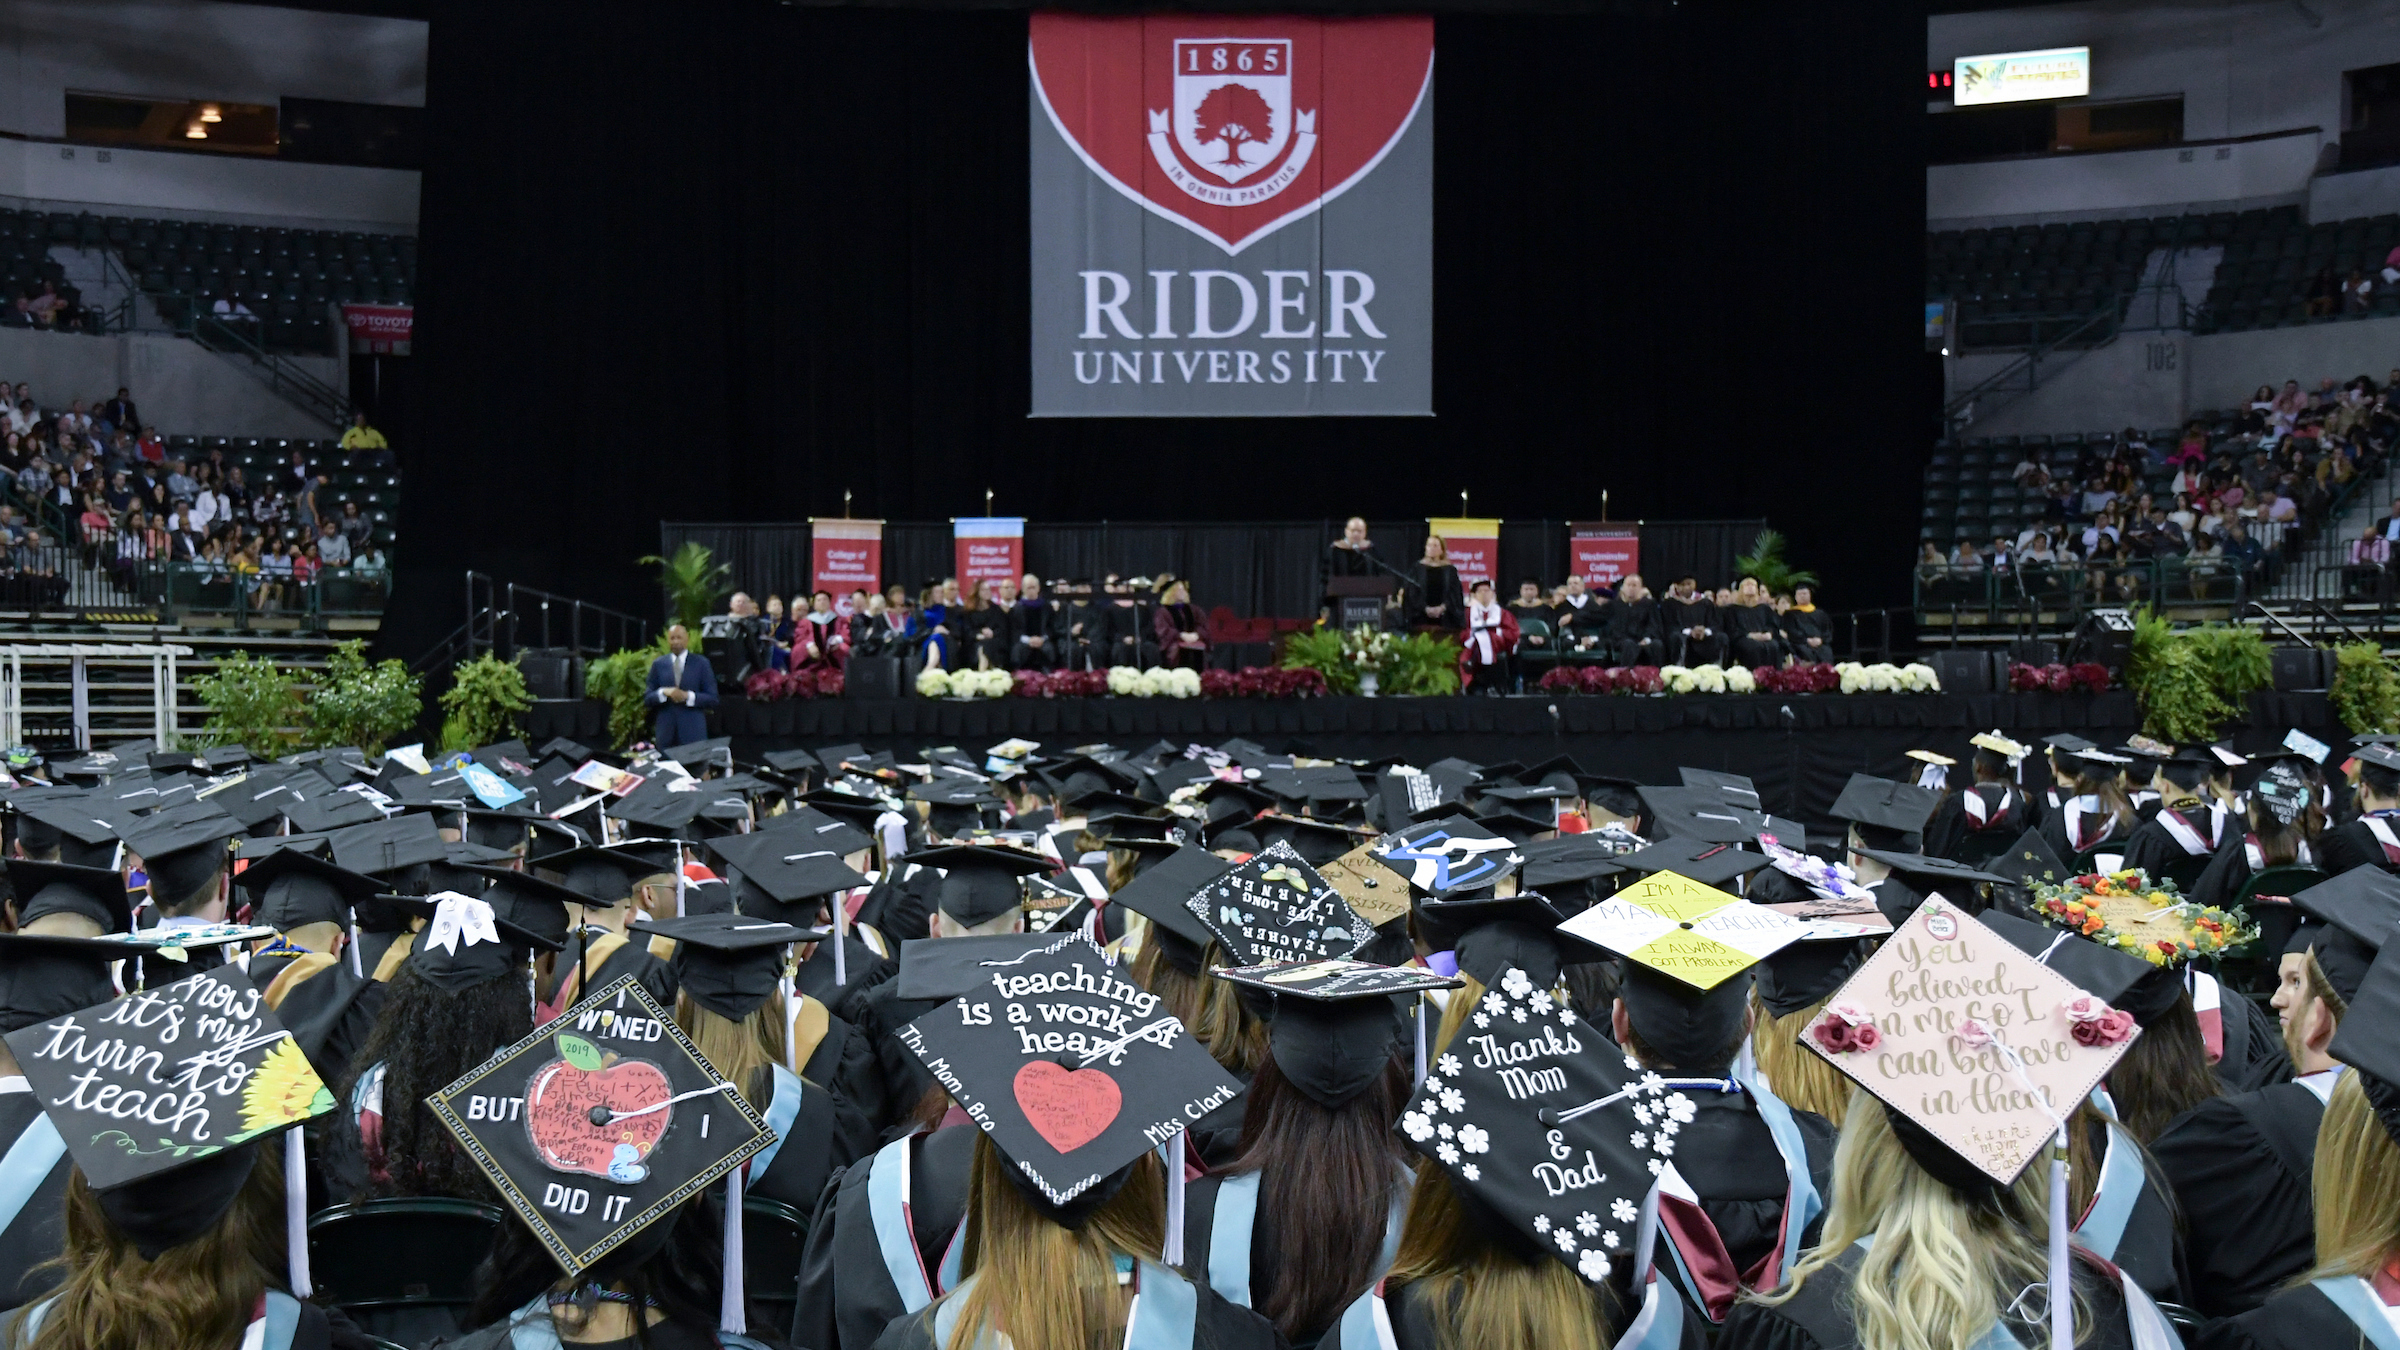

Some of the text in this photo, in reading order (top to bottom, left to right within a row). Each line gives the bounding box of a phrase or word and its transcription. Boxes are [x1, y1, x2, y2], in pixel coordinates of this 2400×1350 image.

[1186, 48, 1280, 72] 1865
[1169, 164, 1297, 204] IN OMNIA PARATUS
[368, 315, 413, 328] TOYOTA
[1077, 270, 1388, 340] RIDER
[1073, 350, 1386, 384] UNIVERSITY
[2146, 343, 2176, 371] 102
[827, 550, 856, 561] College
[1579, 552, 1629, 561] Westminster
[1589, 563, 1619, 573] College
[1593, 573, 1606, 583] the
[1242, 891, 1279, 912] LONG
[1683, 883, 1701, 895] A
[1599, 903, 1791, 932] MATH TEACHER
[1241, 926, 1328, 956] TEACHER
[1250, 943, 1307, 962] UTURE
[1647, 941, 1727, 955] I ALWAYS
[1897, 937, 1976, 973] You
[1651, 956, 1744, 968] GOT PROBLEMS
[172, 972, 263, 1021] now
[992, 963, 1161, 1018] teaching
[1886, 962, 2012, 1008] believed
[2013, 985, 2046, 1024] I
[100, 991, 263, 1066] it's my
[898, 1024, 928, 1058] Thx
[957, 997, 1185, 1051] is a work of
[33, 1016, 254, 1096] turn to
[565, 1042, 590, 1058] 2019
[1013, 1026, 1128, 1066] heart
[1467, 1024, 1582, 1069] Thanks
[1877, 1028, 2071, 1079] can believe
[927, 1058, 964, 1096] Mom
[966, 1101, 996, 1133] Bro
[1496, 1066, 1568, 1100] Mom
[1921, 1073, 2056, 1116] in them
[53, 1067, 211, 1141] teach
[467, 1095, 525, 1122] BUT
[701, 1114, 710, 1139] I
[1143, 1115, 1186, 1147] Miss
[1184, 1084, 1236, 1120] Clark
[1546, 1129, 1572, 1161] &
[1532, 1149, 1607, 1197] Dad
[543, 1182, 632, 1223] DID IT
